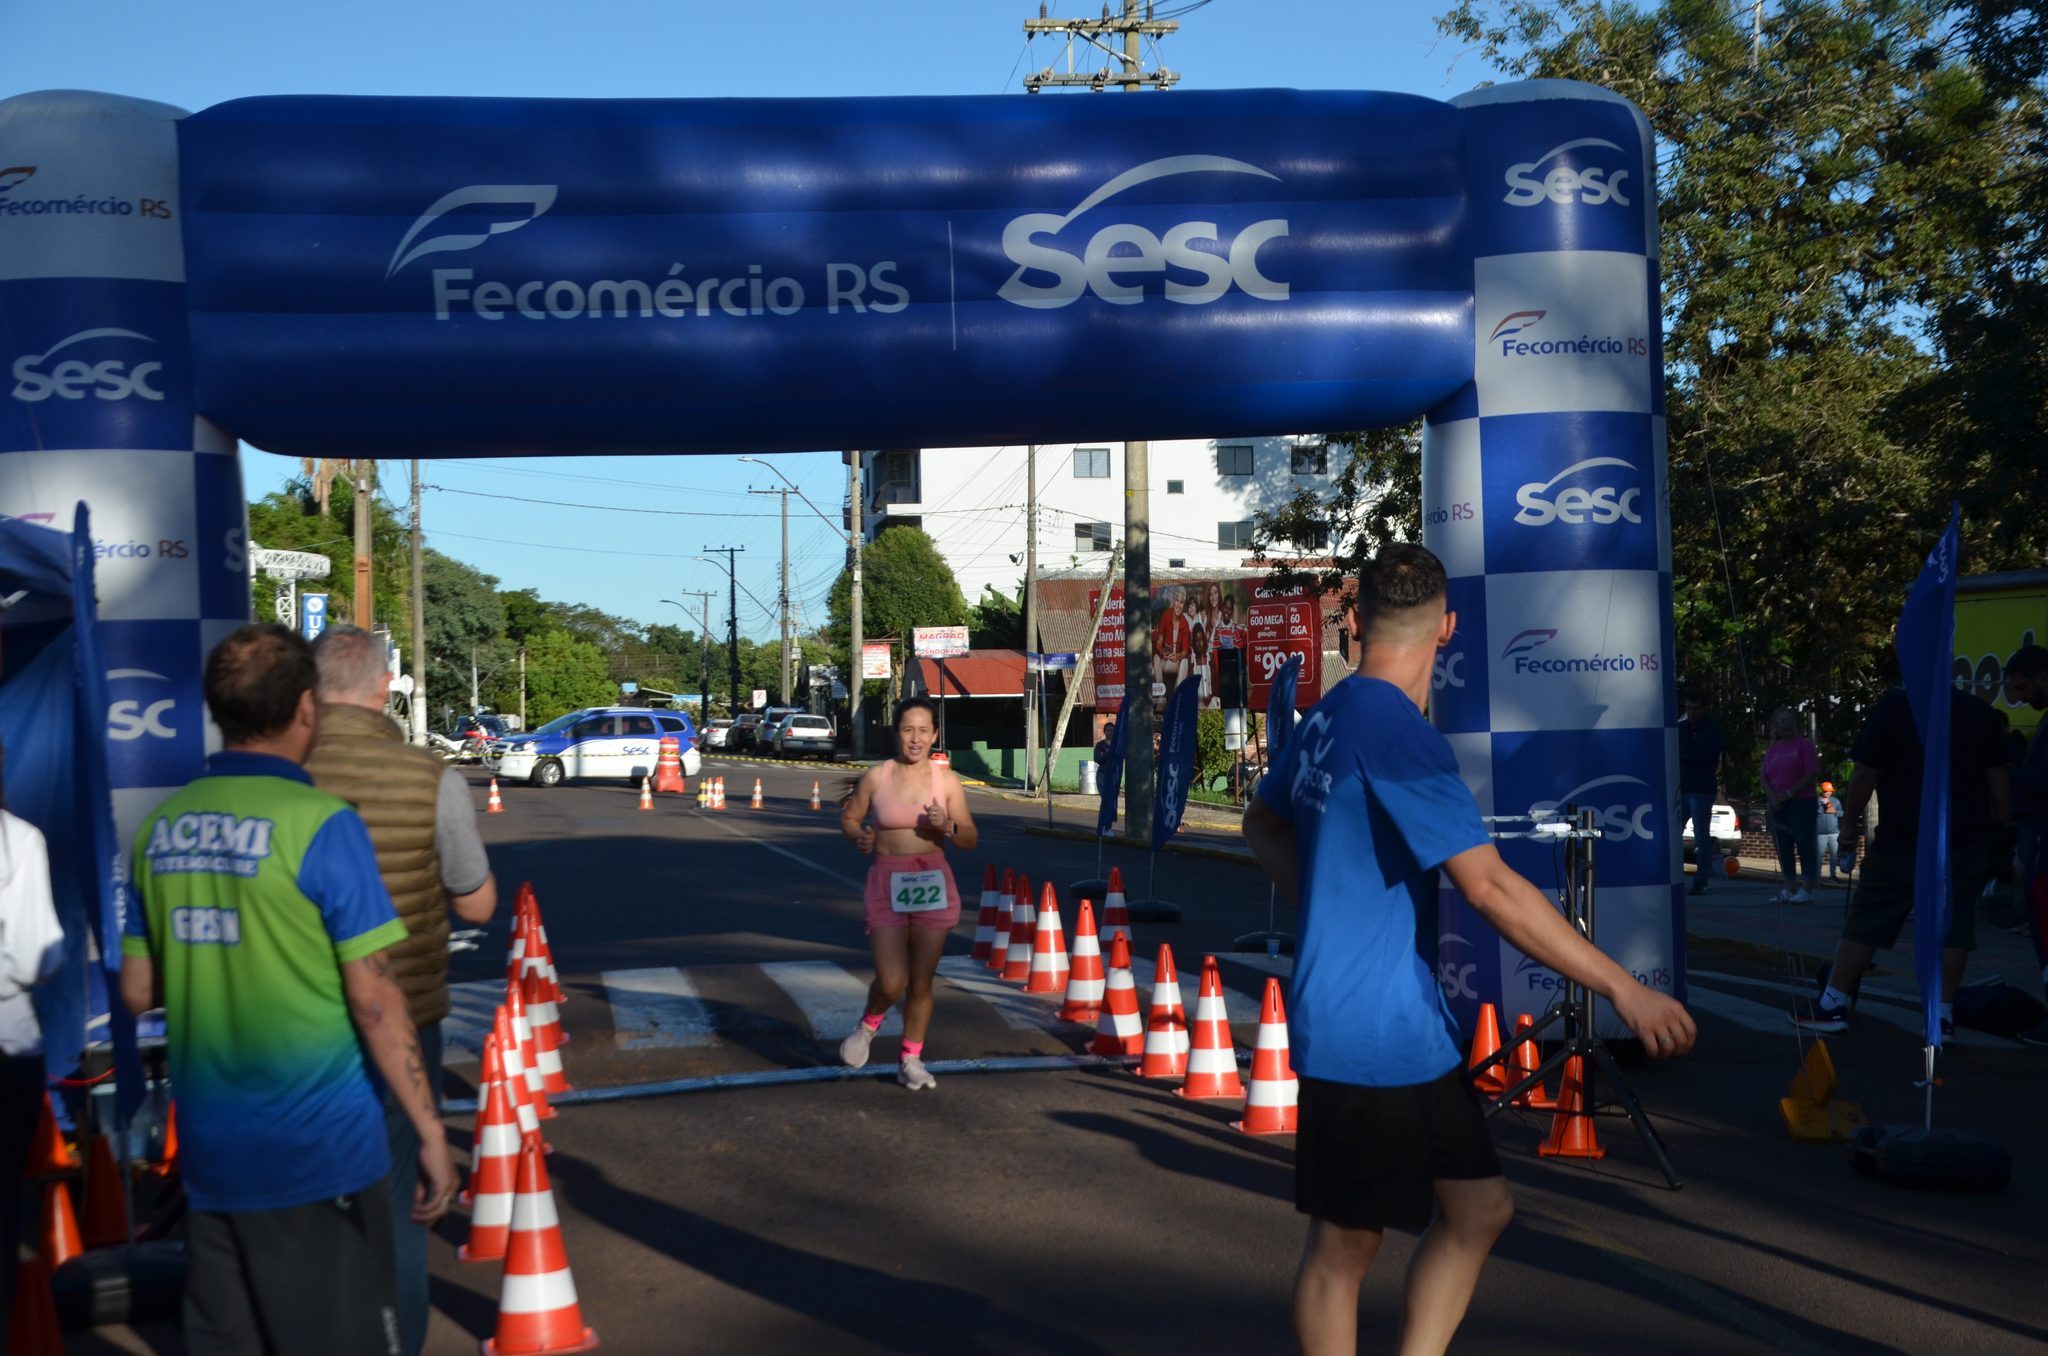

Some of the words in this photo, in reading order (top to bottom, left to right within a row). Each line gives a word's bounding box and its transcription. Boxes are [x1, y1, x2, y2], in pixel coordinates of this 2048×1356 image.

[139, 199, 171, 219] RS
[432, 262, 805, 320] Fecomércio
[826, 261, 910, 314] RS
[1503, 335, 1623, 357] Fecomércio
[1628, 337, 1647, 356] RS
[1452, 502, 1474, 521] RS
[158, 540, 189, 559] RS
[1250, 616, 1263, 626] 600
[1264, 615, 1283, 625] MEGA
[1290, 614, 1300, 624] 60
[1290, 625, 1307, 635] GIGA
[1103, 648, 1112, 658] na
[1515, 654, 1635, 674] Fecomércio
[1640, 654, 1659, 671] RS
[146, 814, 273, 857] ACEMI
[896, 885, 941, 905] 422
[1653, 968, 1670, 985] RS
